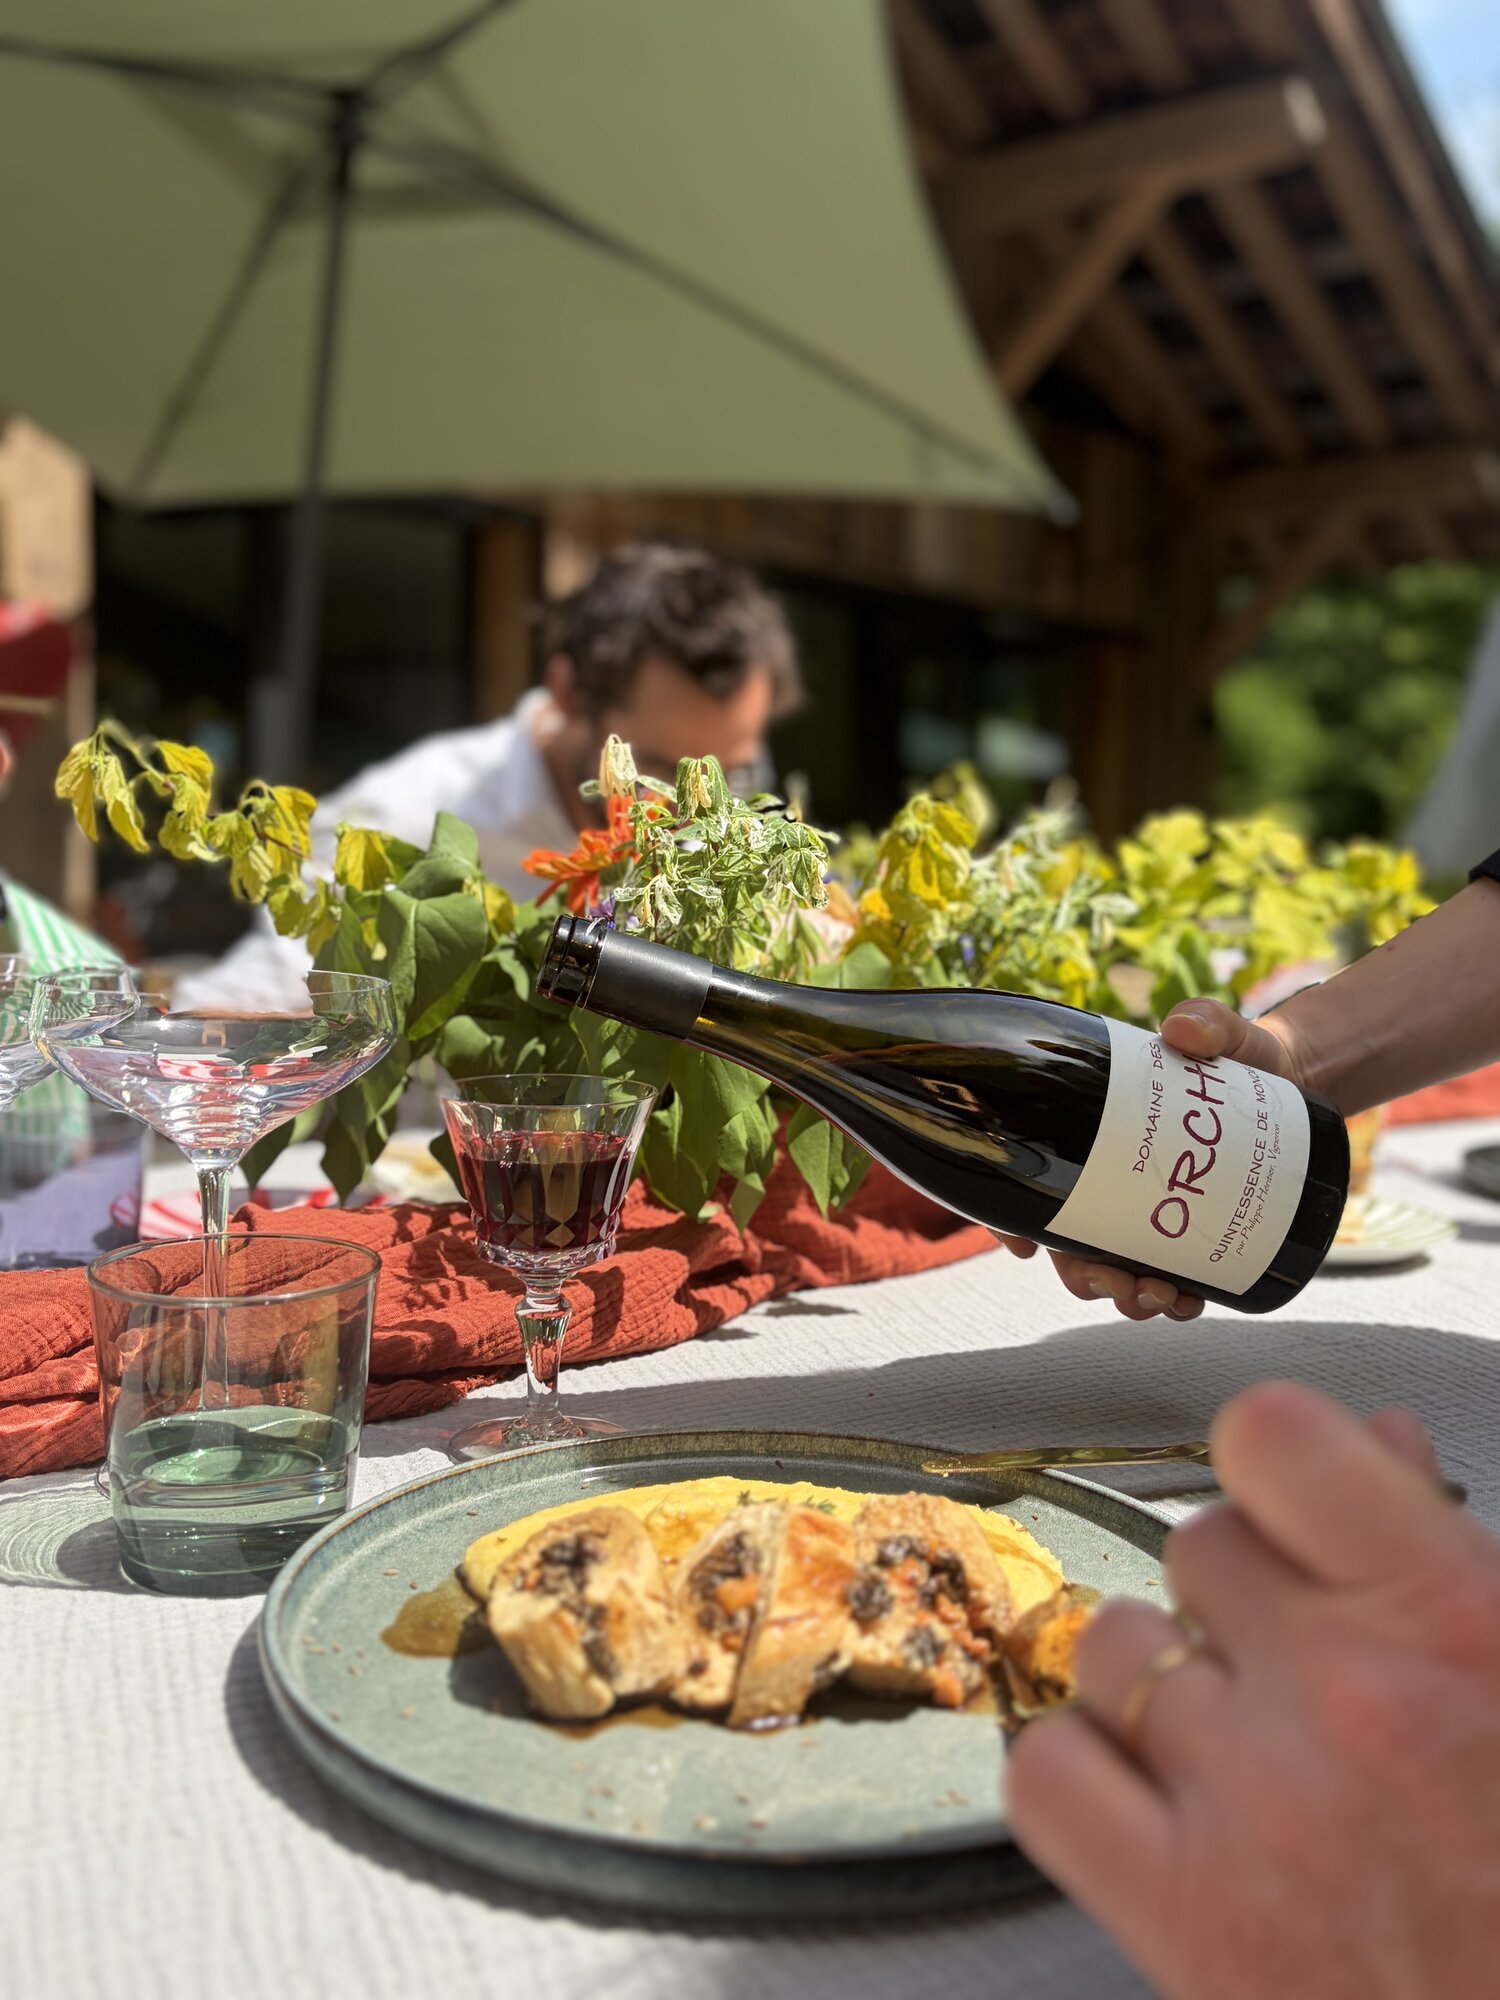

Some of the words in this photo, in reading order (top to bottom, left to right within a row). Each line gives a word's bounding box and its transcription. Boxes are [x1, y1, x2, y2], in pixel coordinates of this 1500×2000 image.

[1133, 1080, 1163, 1172] DOMAINE
[1150, 1042, 1164, 1069] DES
[1151, 1054, 1226, 1238] ORCHI
[1210, 1138, 1266, 1262] QUINTESSENCE
[1257, 1110, 1268, 1132] DE
[1236, 1241, 1245, 1256] par
[1241, 1203, 1264, 1239] Philippe
[1268, 1124, 1280, 1159] Vigneron
